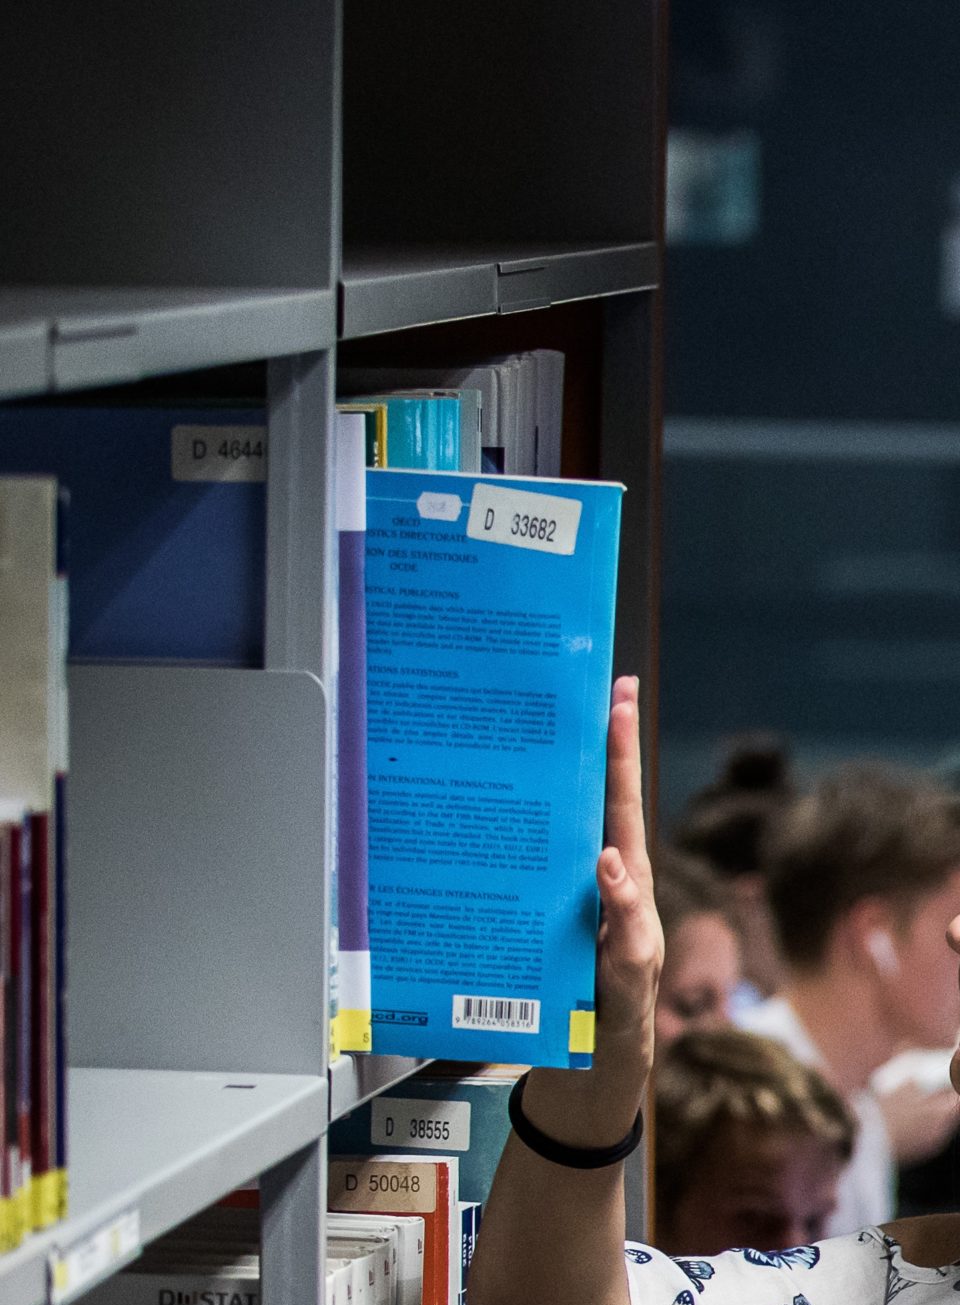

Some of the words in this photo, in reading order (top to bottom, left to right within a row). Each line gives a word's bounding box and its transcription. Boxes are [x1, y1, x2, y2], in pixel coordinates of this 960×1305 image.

[192, 440, 207, 460] D
[218, 440, 264, 460] 4644
[484, 508, 495, 531] D
[510, 513, 557, 543] 33682
[410, 551, 479, 565] STATISTIQUES
[378, 775, 446, 788] INTERNATIONAL
[449, 780, 514, 792] TRANSACTIONS
[445, 889, 520, 902] INTERNATIONAUX
[385, 1117, 395, 1137] D
[410, 1118, 450, 1141] 38555
[345, 1174, 358, 1192] D
[369, 1174, 421, 1193] 50048
